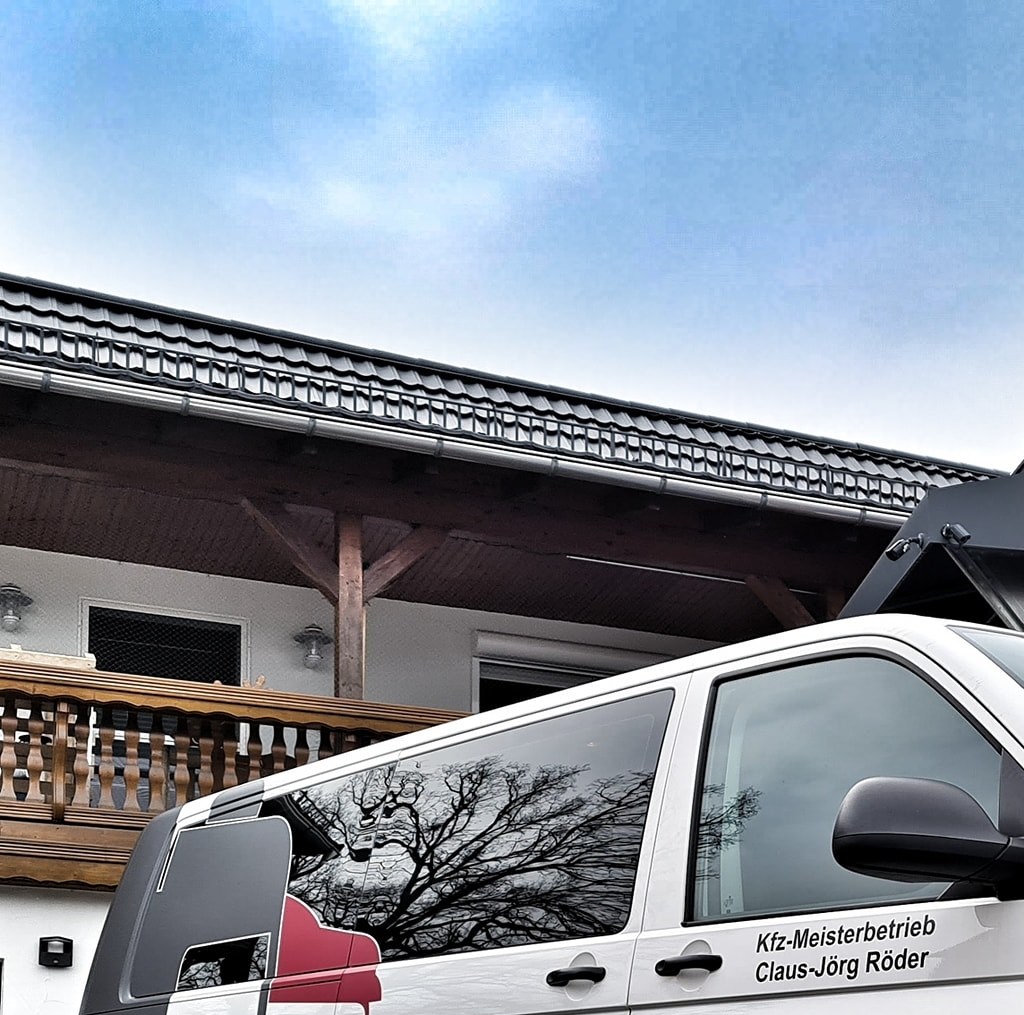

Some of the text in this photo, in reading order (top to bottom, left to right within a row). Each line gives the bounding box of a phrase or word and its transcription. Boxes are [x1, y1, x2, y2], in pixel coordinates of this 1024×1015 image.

[756, 915, 936, 953] Kfz-Meisterbetrieb
[755, 948, 930, 982] Claus-Jörg Röder
